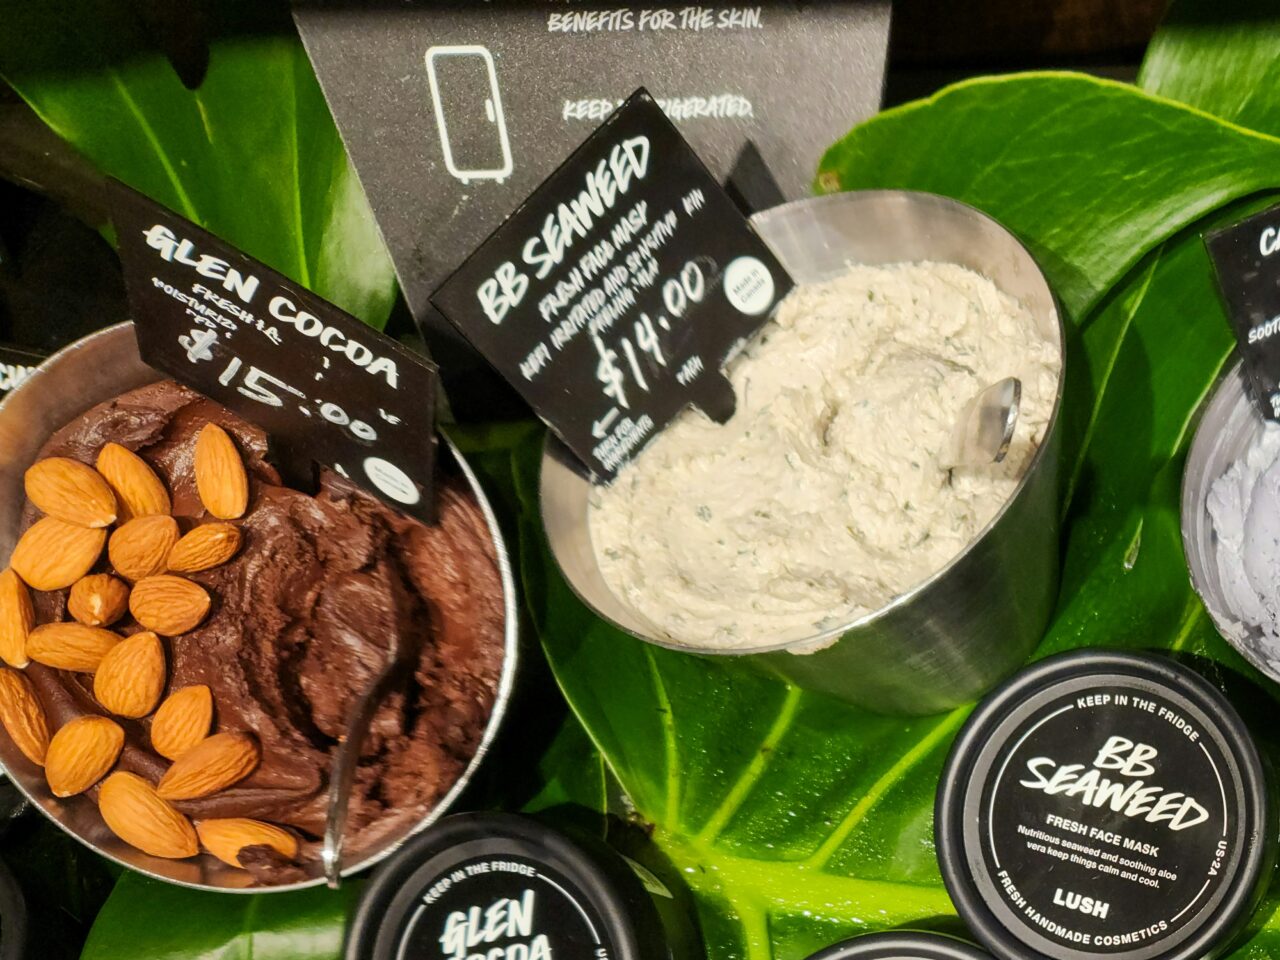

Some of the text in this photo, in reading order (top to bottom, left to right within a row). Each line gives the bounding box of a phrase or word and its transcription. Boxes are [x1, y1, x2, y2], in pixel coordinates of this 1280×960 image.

[548, 7, 763, 32] BENEFITS FOR THE SKIN.
[563, 100, 613, 120] KEEP
[476, 261, 529, 325] BB
[522, 135, 649, 279] SEAWEED
[142, 224, 259, 304] GLEN
[268, 296, 399, 389] COCOA
[1077, 695, 1199, 741] KEEP IN THE FRIDGE
[1093, 736, 1158, 776] BB
[1019, 757, 1209, 831] SEAWEED
[1046, 814, 1159, 857] FRESH FACE MASK
[1027, 842, 1160, 888] vera keep things calm and cool.
[439, 889, 535, 959] GLEN
[998, 870, 1168, 945] FRESH HANDMADE COSMETICS
[1053, 888, 1109, 919] LUSH
